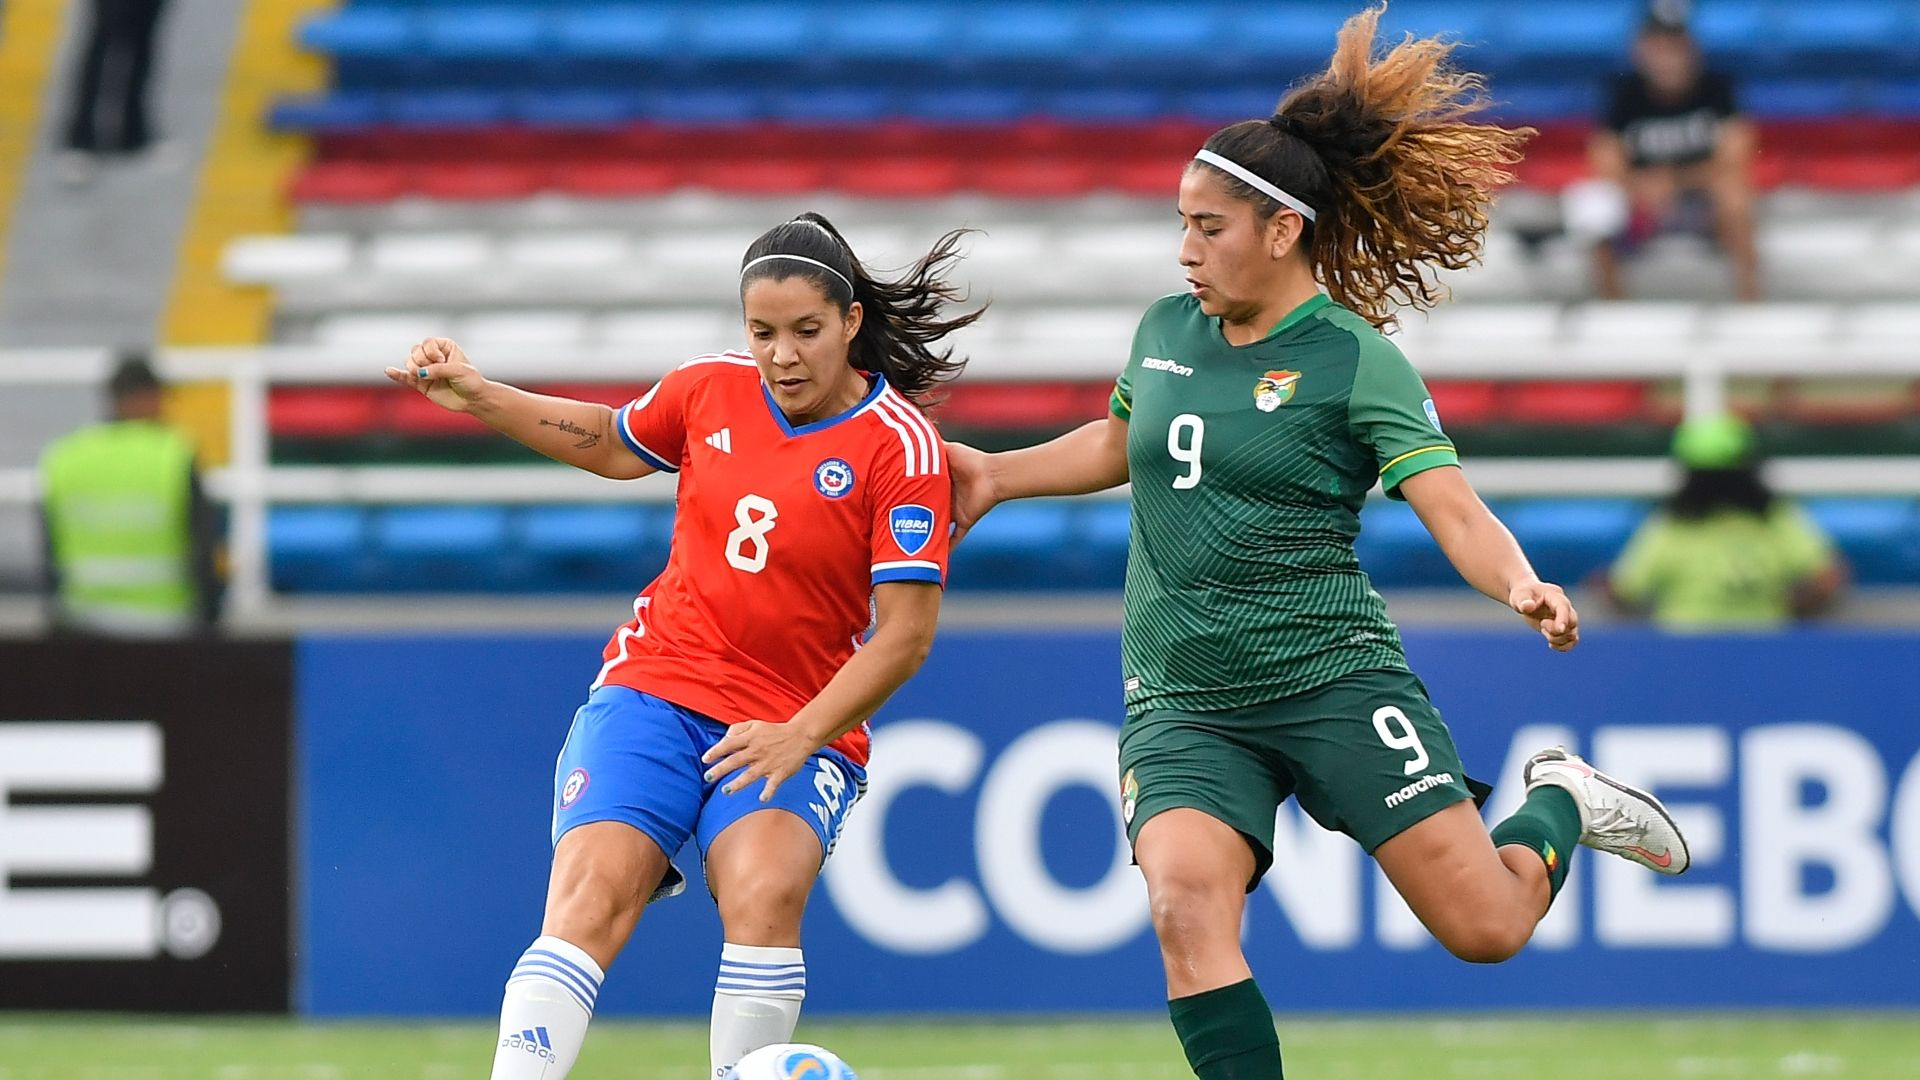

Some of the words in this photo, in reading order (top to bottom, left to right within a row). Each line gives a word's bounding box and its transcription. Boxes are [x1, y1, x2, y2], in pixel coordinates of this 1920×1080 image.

[1167, 413, 1205, 490] 9
[725, 493, 779, 574] 8
[894, 518, 929, 530] VIBRA
[1372, 705, 1430, 776] 9
[813, 757, 846, 817] 8
[1384, 772, 1455, 809] marathon
[823, 718, 1920, 956] COEB
[501, 1037, 556, 1065] adidas
